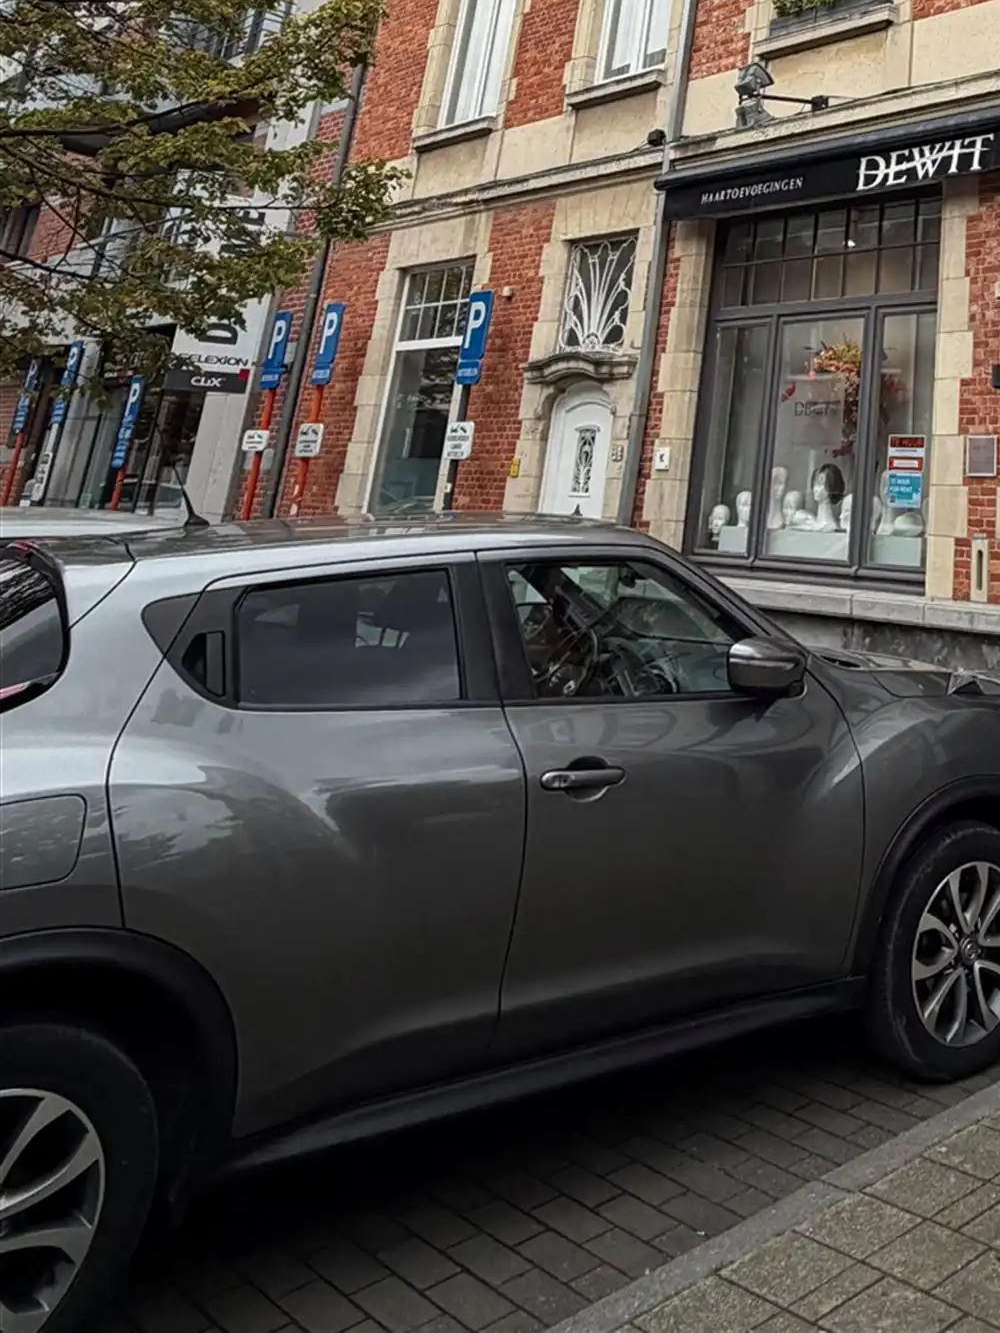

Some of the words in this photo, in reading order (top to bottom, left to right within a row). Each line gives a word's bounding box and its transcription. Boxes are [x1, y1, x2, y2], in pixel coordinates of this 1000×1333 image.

[856, 133, 995, 191] DEWIT
[701, 176, 804, 205] HAARTOEVOEGINGEN
[267, 319, 286, 360] P
[319, 312, 338, 355] P
[464, 300, 486, 350] P
[124, 382, 140, 417] P
